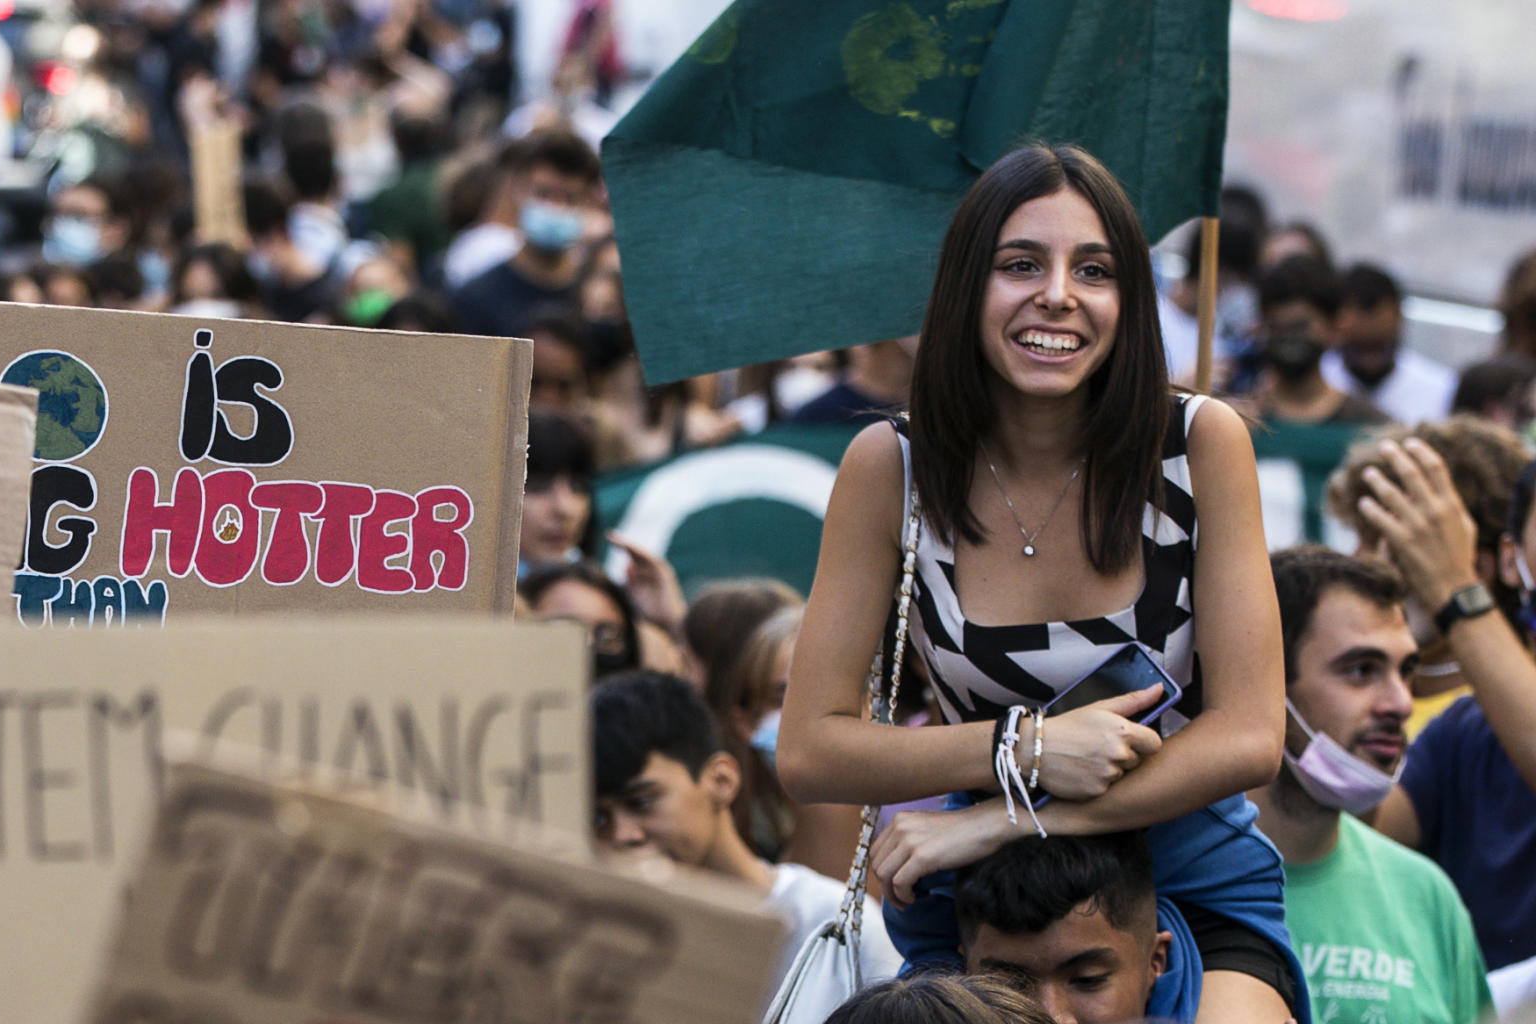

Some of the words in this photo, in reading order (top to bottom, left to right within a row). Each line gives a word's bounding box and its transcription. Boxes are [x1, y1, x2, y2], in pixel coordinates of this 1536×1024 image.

[119, 466, 475, 595] HOTTER
[11, 575, 170, 629] THAN
[1302, 943, 1415, 989] VERDE
